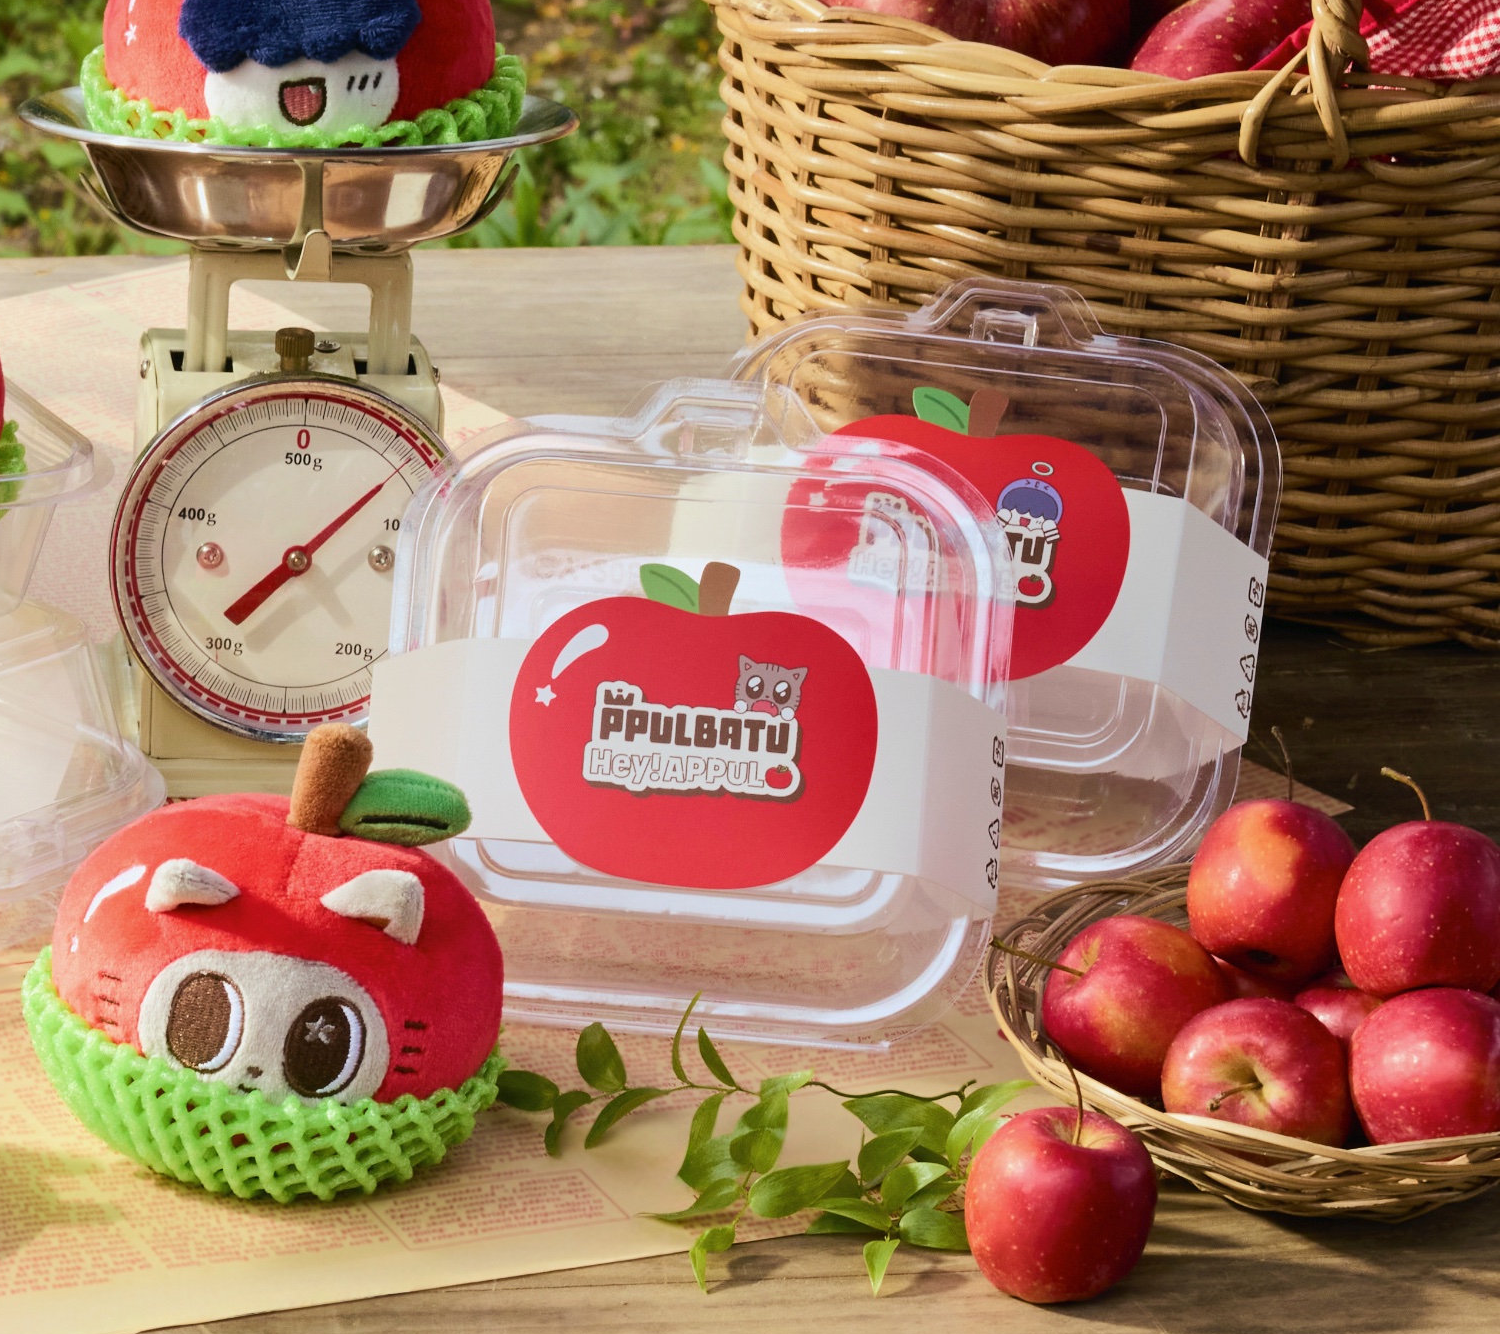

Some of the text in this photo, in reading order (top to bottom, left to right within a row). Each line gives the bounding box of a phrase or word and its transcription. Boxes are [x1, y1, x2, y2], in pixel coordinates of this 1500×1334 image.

[297, 429, 311, 449] 0
[284, 452, 323, 471] 500g
[177, 507, 217, 526] 400g
[205, 637, 244, 656] 300g
[335, 642, 373, 660] 200g
[599, 707, 790, 754] PPULBATU
